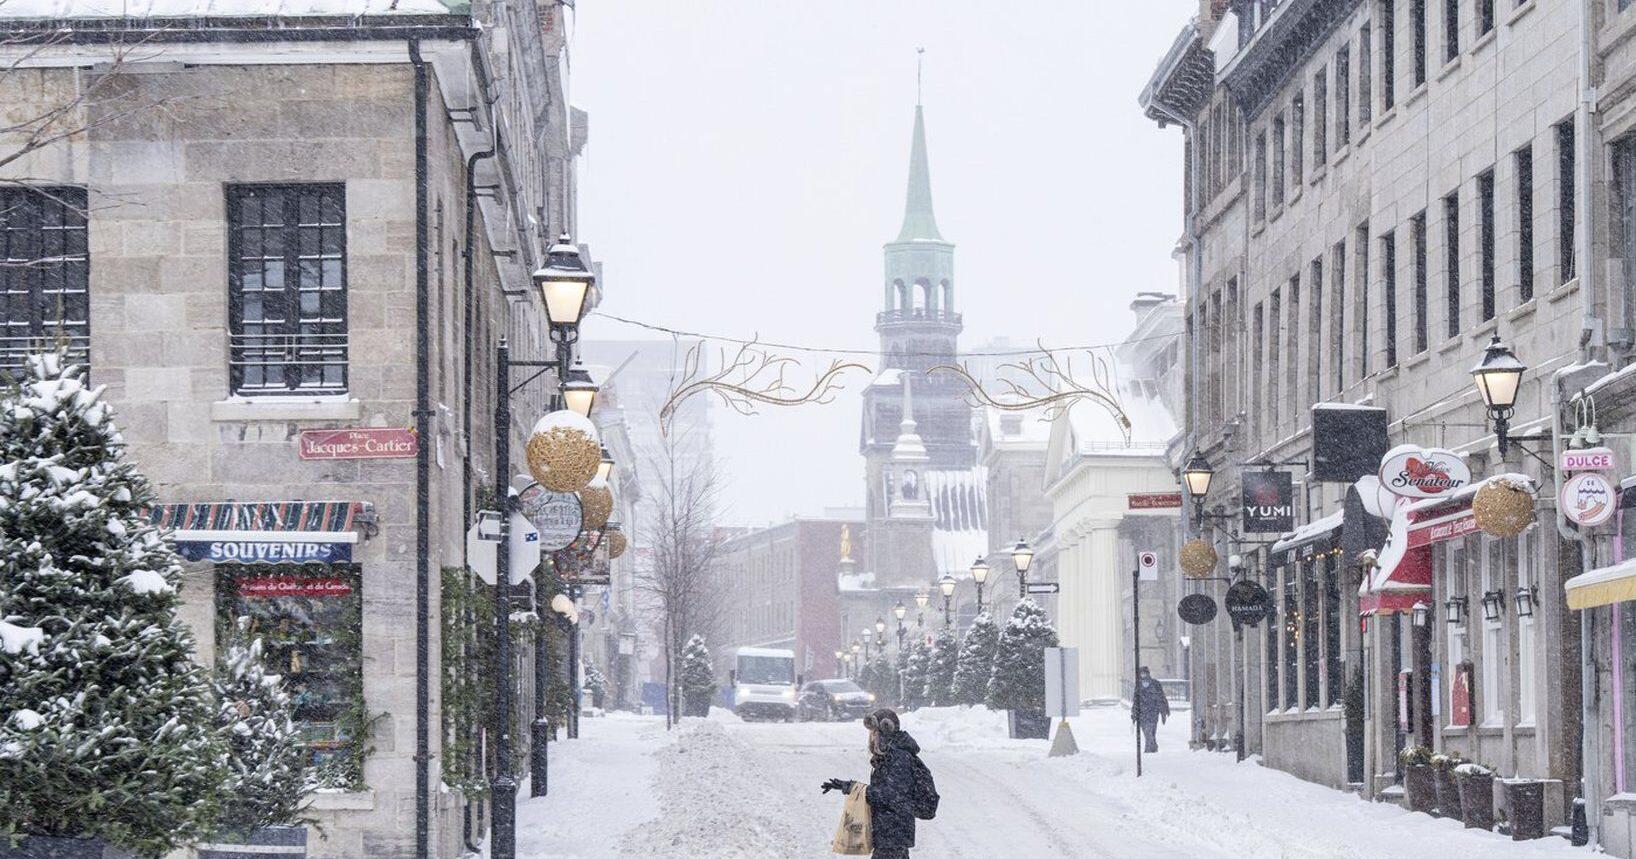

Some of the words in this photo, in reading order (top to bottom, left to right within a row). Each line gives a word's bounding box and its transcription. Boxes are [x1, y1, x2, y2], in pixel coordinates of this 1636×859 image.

[306, 439, 412, 457] Jacques-Cartier
[1567, 455, 1609, 467] DULCE
[1246, 505, 1291, 518] YUMI
[210, 542, 332, 558] SOUVENIRS
